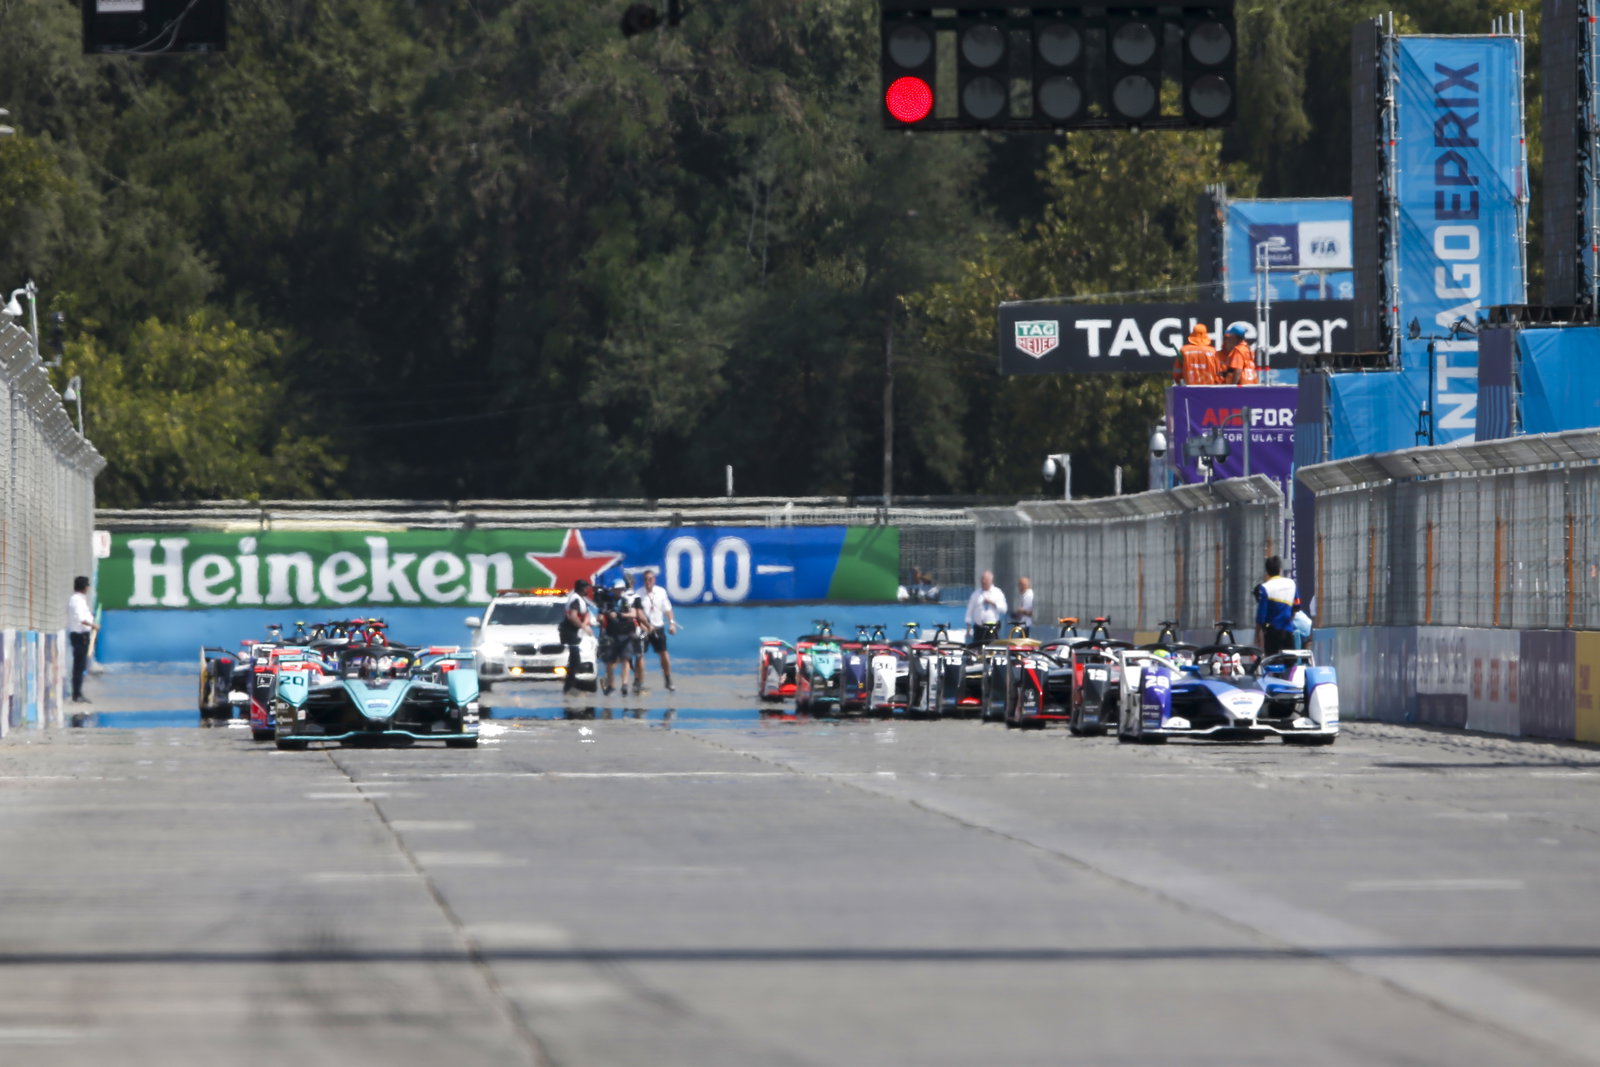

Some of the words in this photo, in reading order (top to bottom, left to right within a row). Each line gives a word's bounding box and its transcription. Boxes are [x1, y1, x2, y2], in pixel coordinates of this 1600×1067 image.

[1310, 240, 1337, 256] FIA
[1019, 323, 1055, 337] TAG
[1018, 337, 1057, 354] HEUER
[1250, 407, 1297, 427] FOR
[127, 536, 514, 607] Heineken
[1023, 659, 1049, 672] 23
[280, 675, 304, 688] 20
